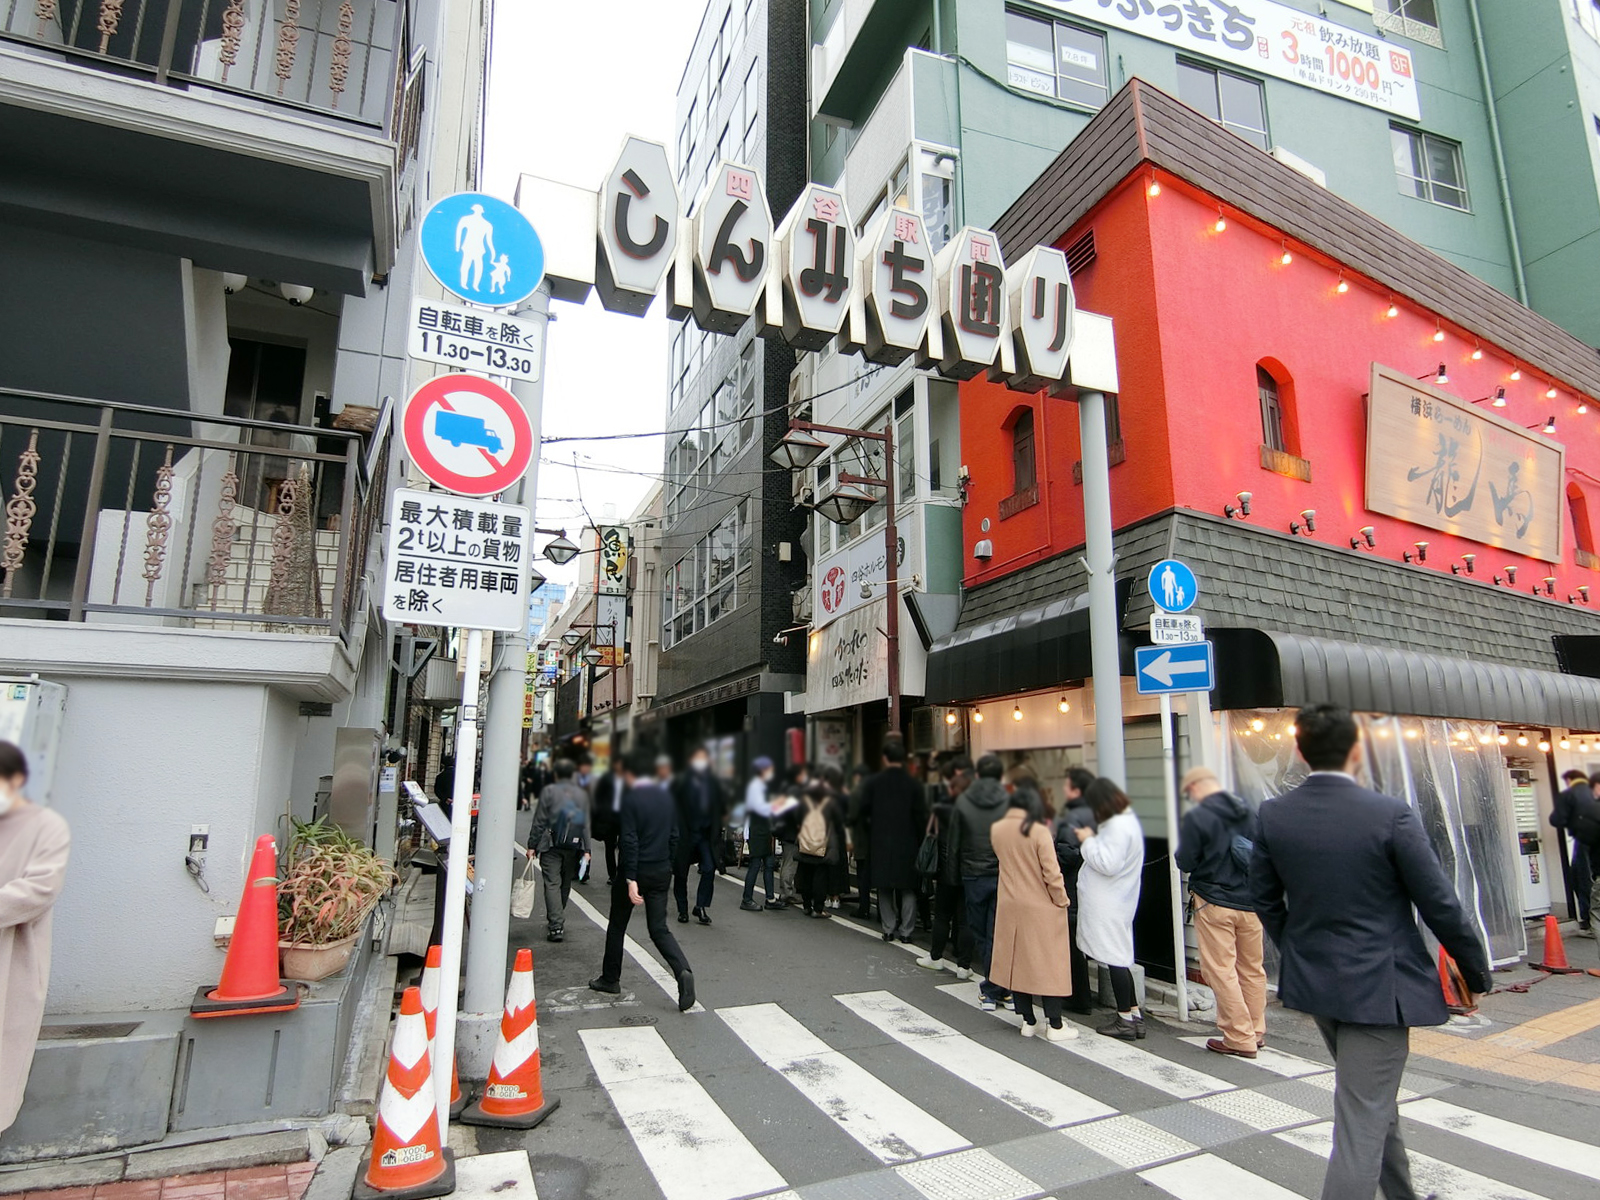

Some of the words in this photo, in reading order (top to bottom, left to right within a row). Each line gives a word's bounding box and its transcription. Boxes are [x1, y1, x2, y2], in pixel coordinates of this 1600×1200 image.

[1292, 17, 1317, 36] 元祖
[1319, 25, 1380, 61] 飲み放題
[1392, 55, 1407, 74] 3F
[726, 170, 992, 262] 四谷駅前
[613, 168, 1069, 352] しんみち通り
[418, 306, 534, 349] 自転車を除く
[1410, 395, 1472, 436] 横浜らーめん
[399, 500, 523, 539] 最大積載量
[397, 526, 520, 564] 2t以上の貨物
[393, 560, 519, 595] 居住者用車両
[393, 588, 443, 614] を除く
[1154, 618, 1197, 630] 自転車を除く
